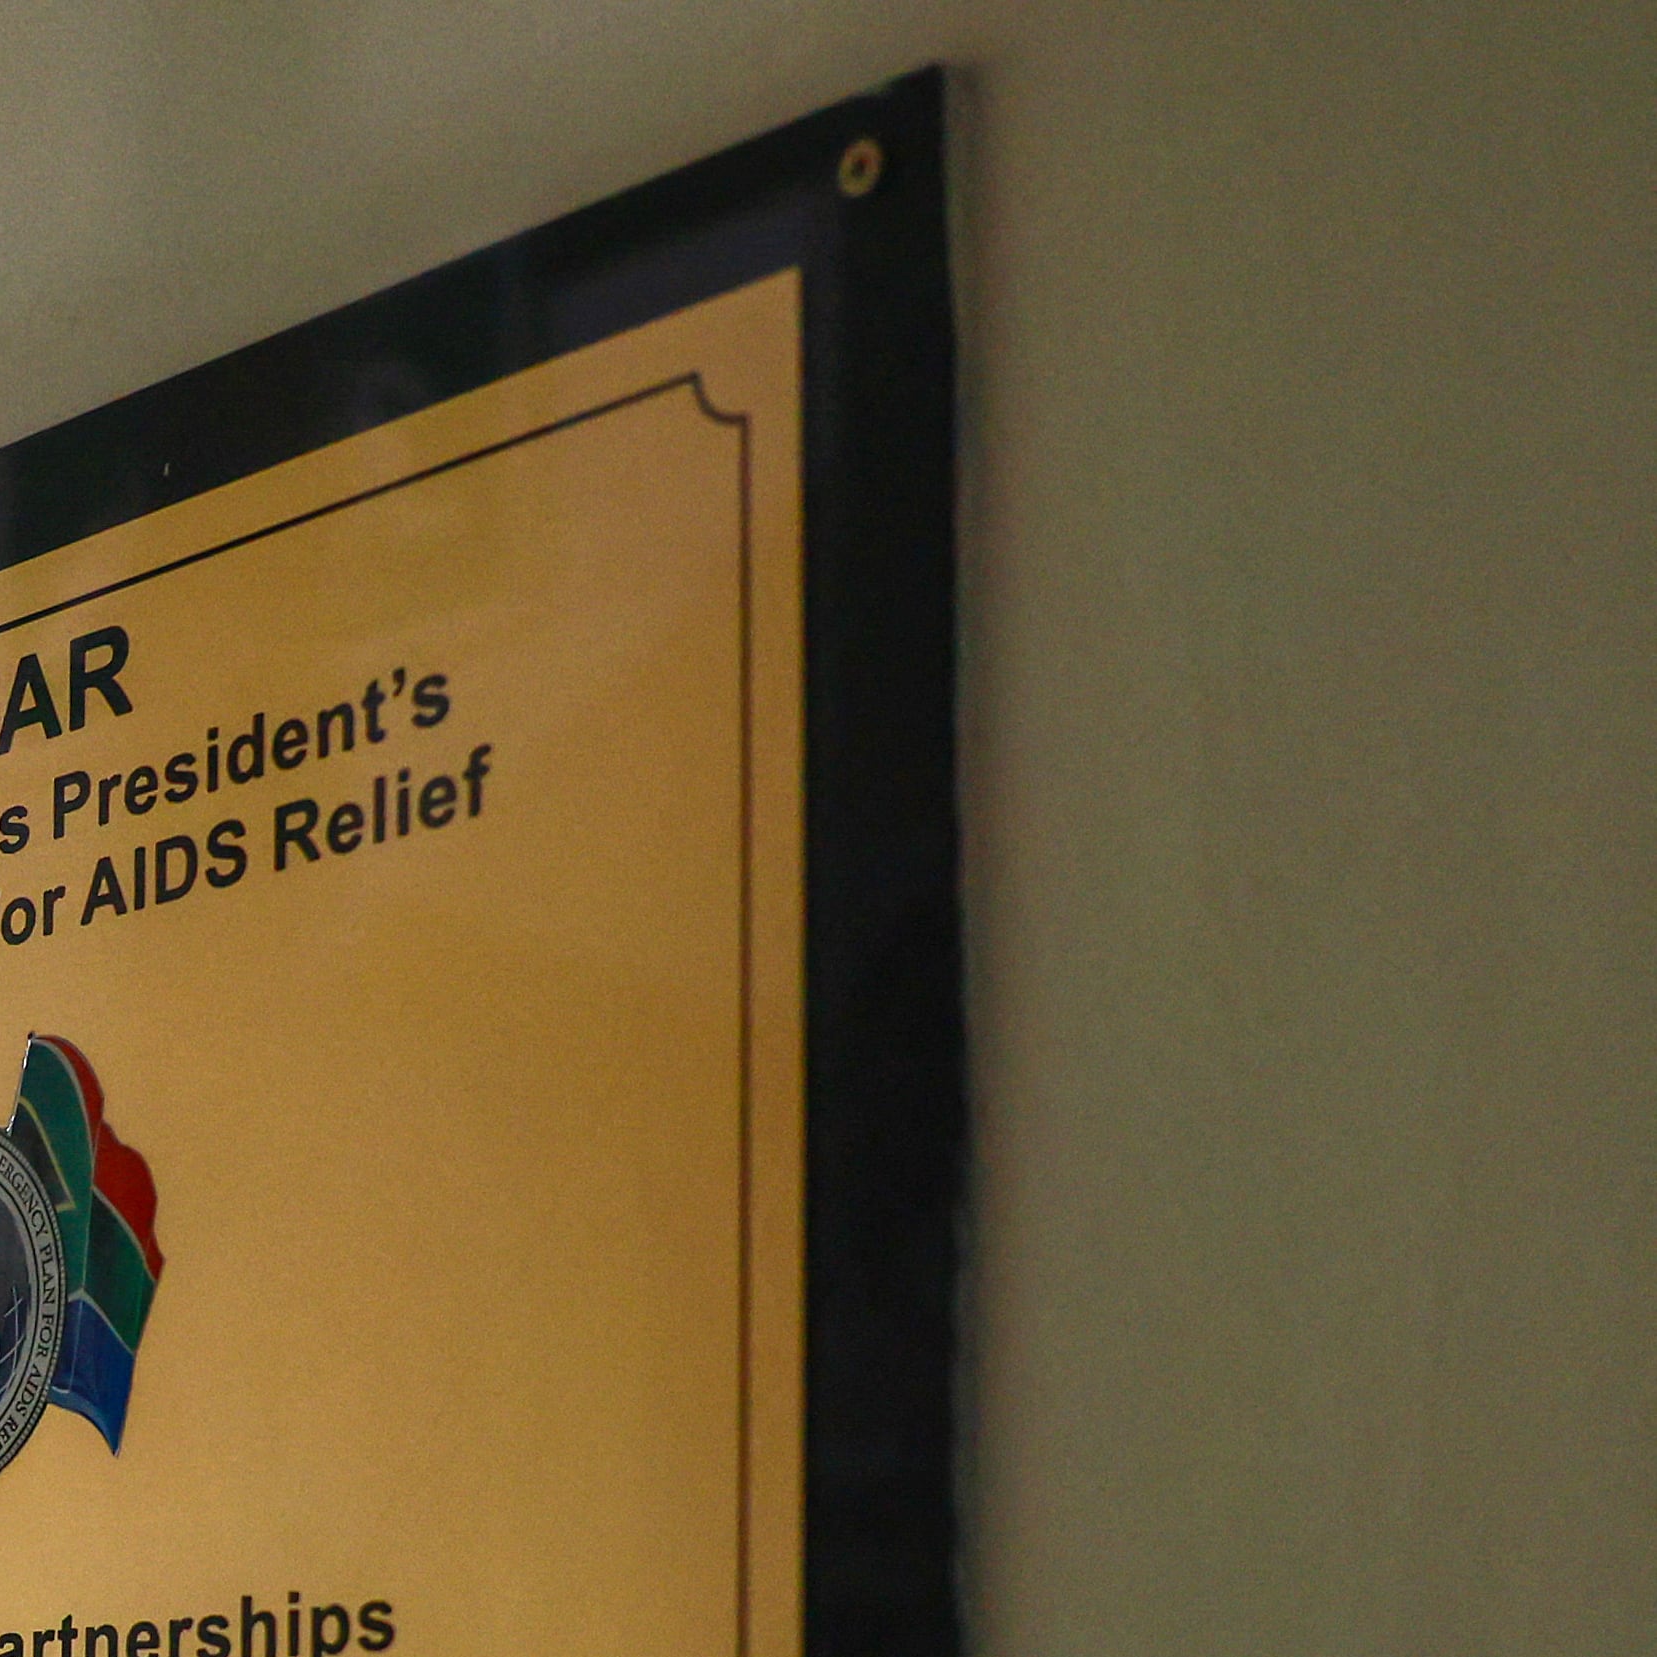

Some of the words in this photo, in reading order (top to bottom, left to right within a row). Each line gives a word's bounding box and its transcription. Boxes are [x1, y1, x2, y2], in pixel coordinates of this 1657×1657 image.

[79, 818, 249, 928] AIDS
[272, 742, 494, 874] Relief
[38, 1242, 56, 1306] PLAN
[37, 1315, 56, 1358] FOR
[15, 1363, 42, 1417] AIDS
